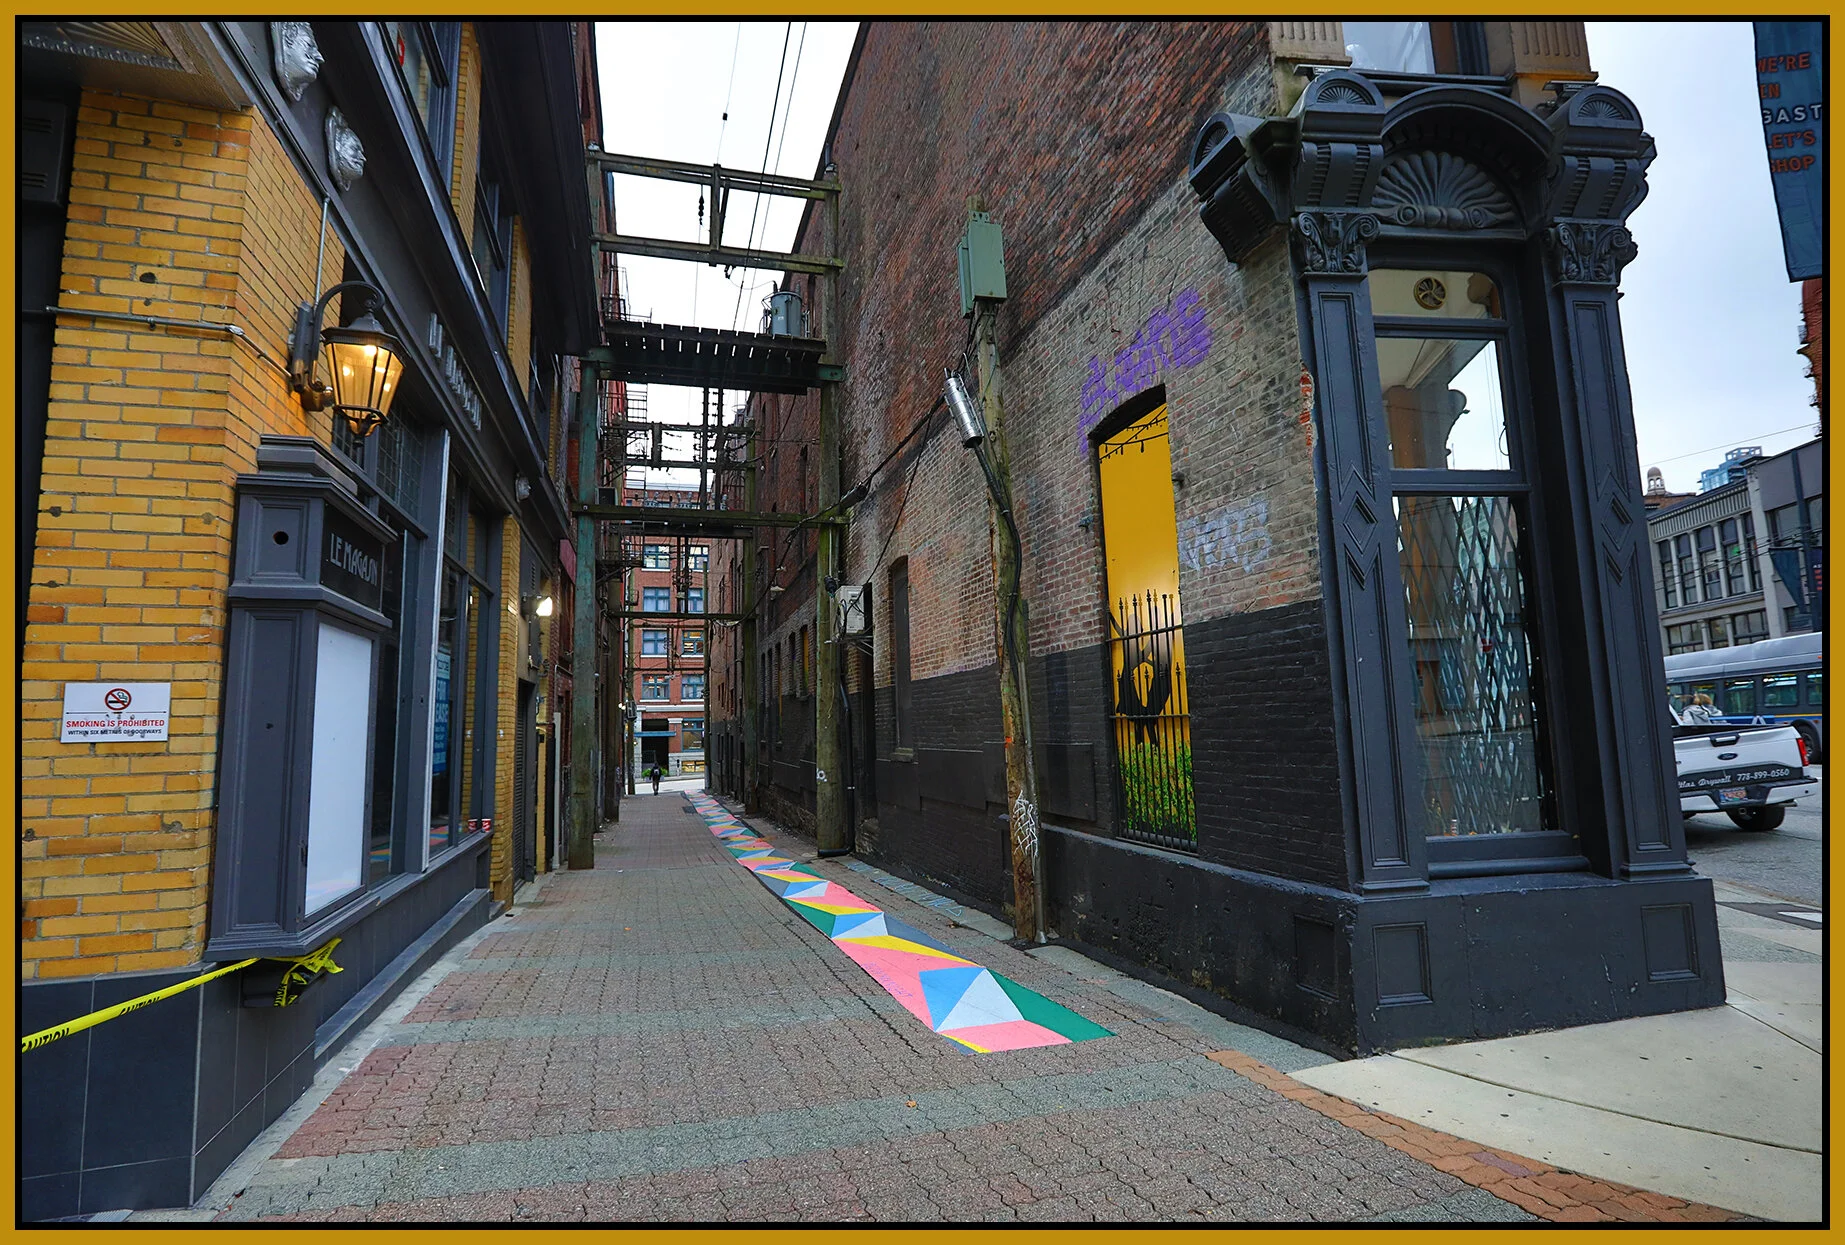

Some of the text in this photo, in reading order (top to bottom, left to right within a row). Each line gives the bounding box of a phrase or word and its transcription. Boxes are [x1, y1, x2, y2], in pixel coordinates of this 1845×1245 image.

[1768, 131, 1816, 148] ET'S
[435, 702, 449, 723] EASE
[66, 719, 165, 728] SMOKING IS PROHIBITED
